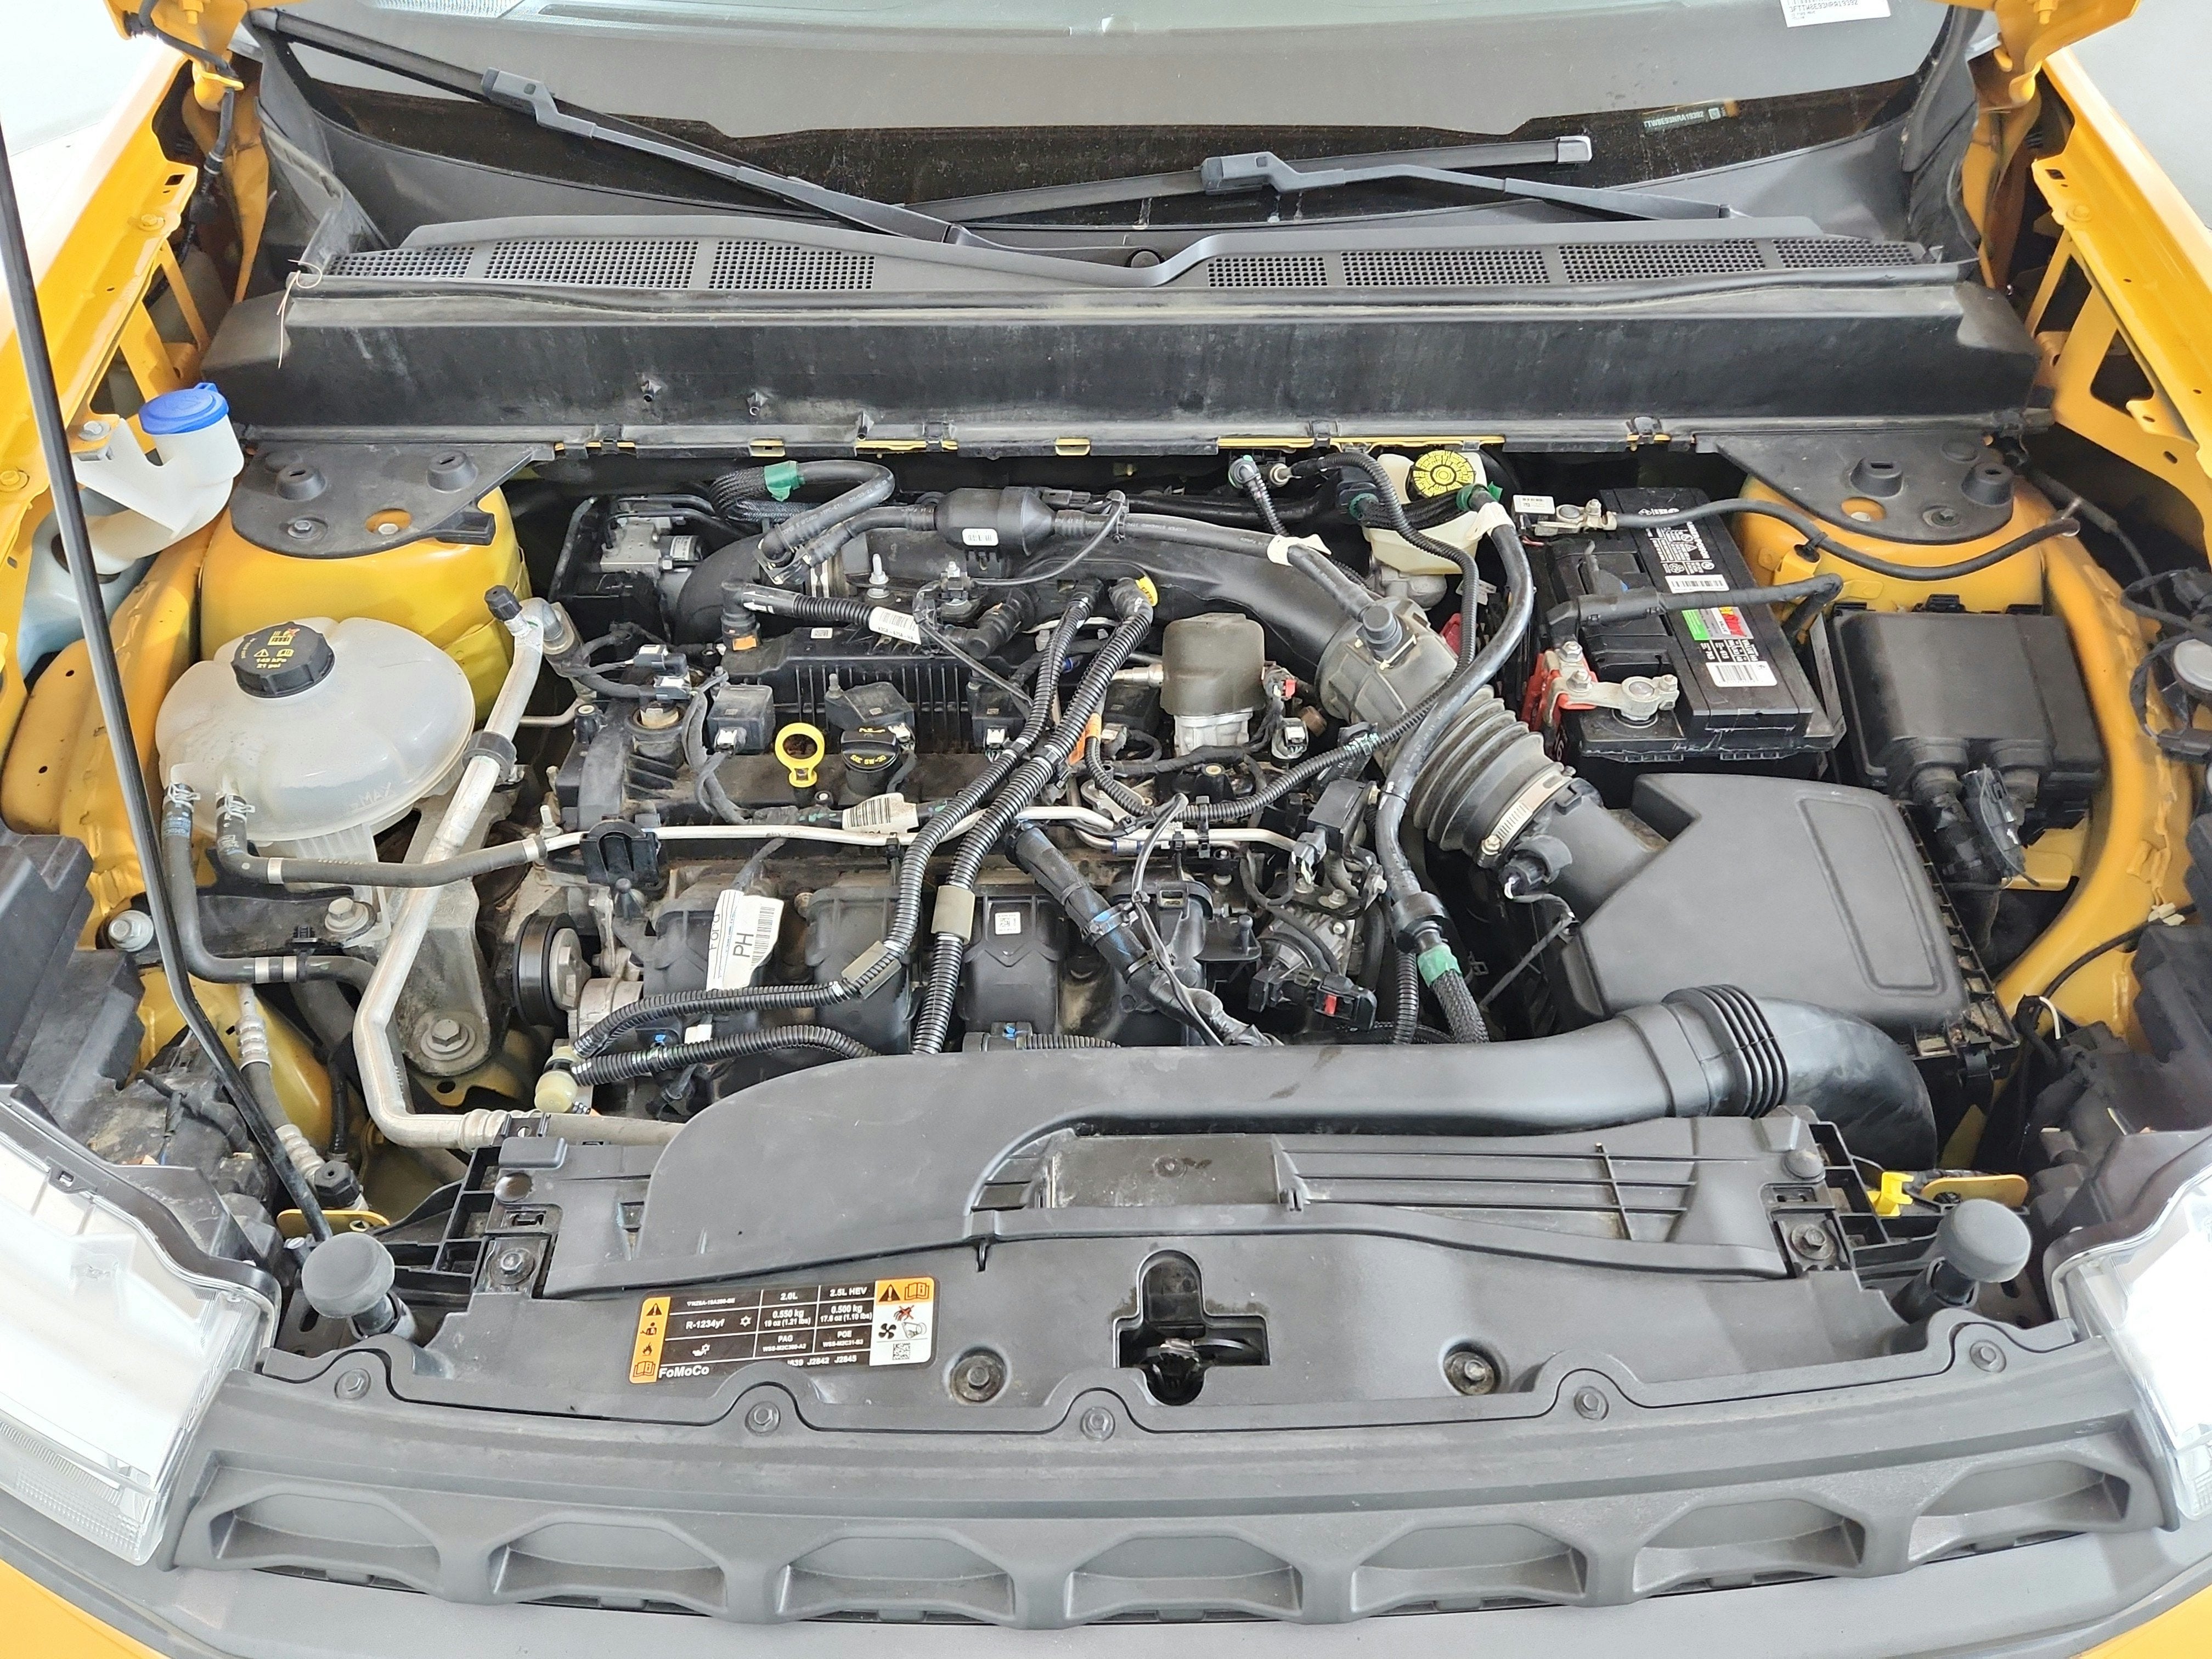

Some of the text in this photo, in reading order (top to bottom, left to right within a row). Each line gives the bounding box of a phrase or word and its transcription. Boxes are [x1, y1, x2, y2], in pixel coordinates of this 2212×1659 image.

[850, 754, 887, 765] SAE 5W-30
[358, 782, 393, 806] MAX
[732, 932, 754, 958] PH
[780, 1291, 798, 1301] 2.0L
[830, 1286, 867, 1297] 2.5L HEV
[772, 1308, 805, 1319] 0.550 kg
[831, 1304, 863, 1314] 0.500 kg
[782, 1318, 797, 1327] (1.21
[798, 1317, 811, 1325] lbs)
[860, 1312, 872, 1321] lbs)
[686, 1318, 725, 1330] R-1234yf
[777, 1335, 793, 1343] PAG
[837, 1330, 853, 1339] POE
[807, 1357, 830, 1366] J2842
[834, 1355, 857, 1364] J2845
[658, 1365, 710, 1378] FoMoCo
